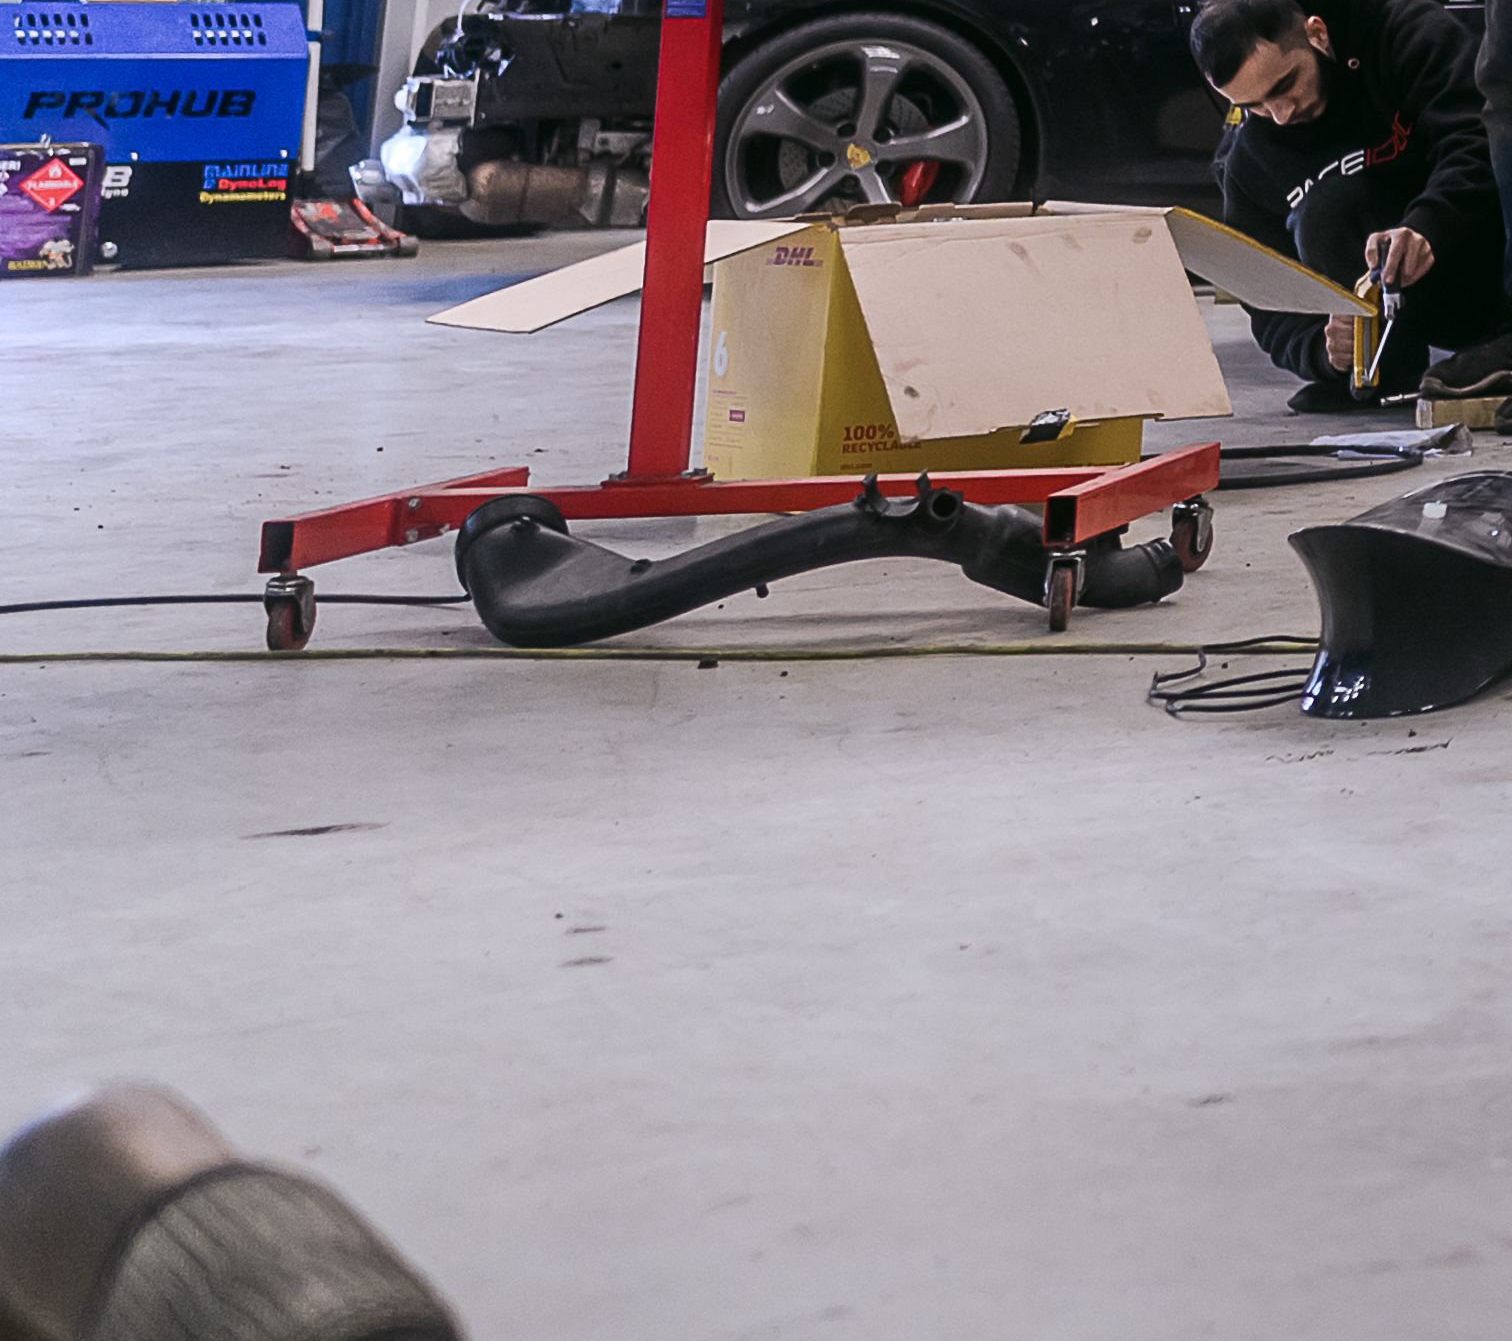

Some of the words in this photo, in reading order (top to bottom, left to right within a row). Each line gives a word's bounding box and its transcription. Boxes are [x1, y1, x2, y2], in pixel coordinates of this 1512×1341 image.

[23, 89, 257, 129] PROHUB
[772, 246, 818, 267] DHL
[712, 330, 729, 378] 6
[843, 423, 895, 442] 100%
